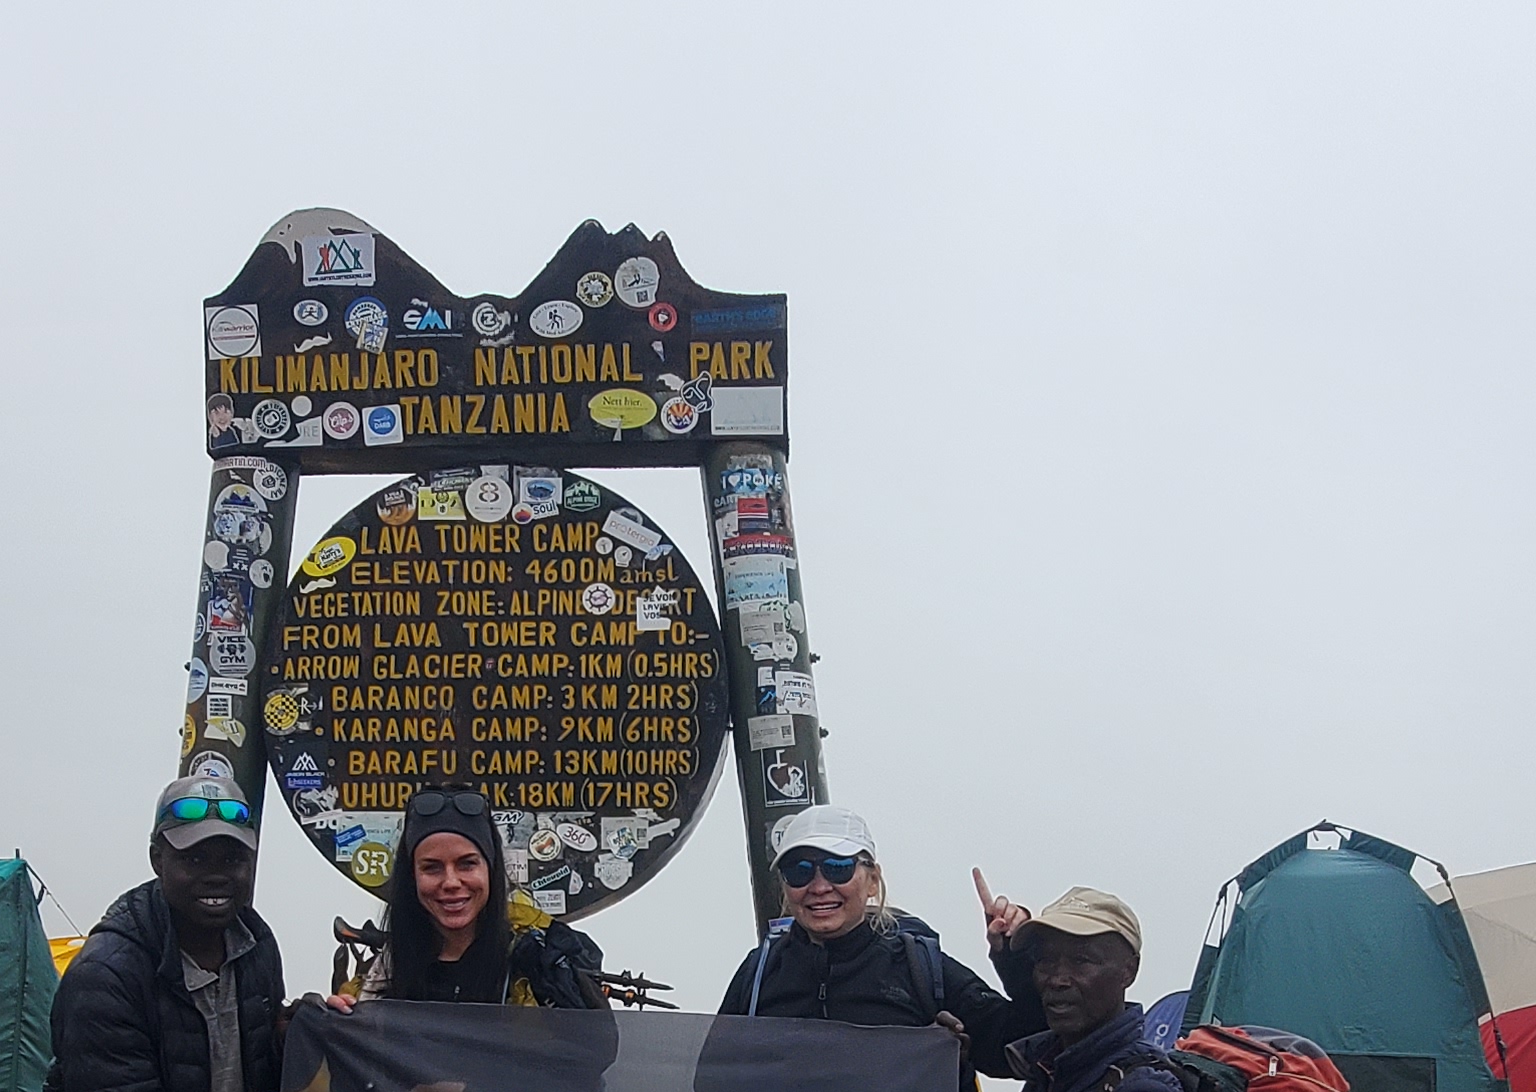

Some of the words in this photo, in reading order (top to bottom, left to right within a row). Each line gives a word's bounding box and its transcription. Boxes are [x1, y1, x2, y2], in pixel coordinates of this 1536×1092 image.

[402, 306, 452, 331] SMI
[219, 349, 439, 394] KILIMANJARO
[474, 342, 644, 386] NATIONAL
[689, 340, 775, 380] PARK
[399, 392, 571, 435] TANZANIA
[602, 395, 623, 407] Nett
[532, 502, 557, 516] soul
[360, 525, 422, 555] LAVA
[434, 523, 520, 554] TOWER
[532, 521, 600, 553] CAMP
[350, 559, 513, 585] ELEVATION:
[525, 558, 614, 584] 4600M
[620, 556, 679, 584] amsl
[292, 591, 421, 618] VEGETATION
[436, 590, 505, 616] ZONE:
[510, 589, 585, 616] ALPINE
[612, 587, 697, 616] DERT
[216, 635, 247, 644] VICE
[283, 623, 361, 650] FROM
[373, 622, 442, 648] LAVA
[463, 620, 557, 647] TOWER
[571, 621, 645, 647] CAMP
[219, 655, 247, 664] GYM
[283, 655, 360, 681] ARROW
[372, 653, 482, 680] GLACIER
[497, 653, 575, 678] CAMP:
[579, 652, 622, 679] 1KM
[331, 685, 455, 712] BARANCO
[471, 683, 554, 711] CAMP:
[332, 717, 456, 743] KARANGA
[471, 716, 547, 743] CAMP:
[348, 749, 457, 776] BARAFU
[471, 750, 545, 775] CAMP:
[342, 781, 424, 809] UHUR
